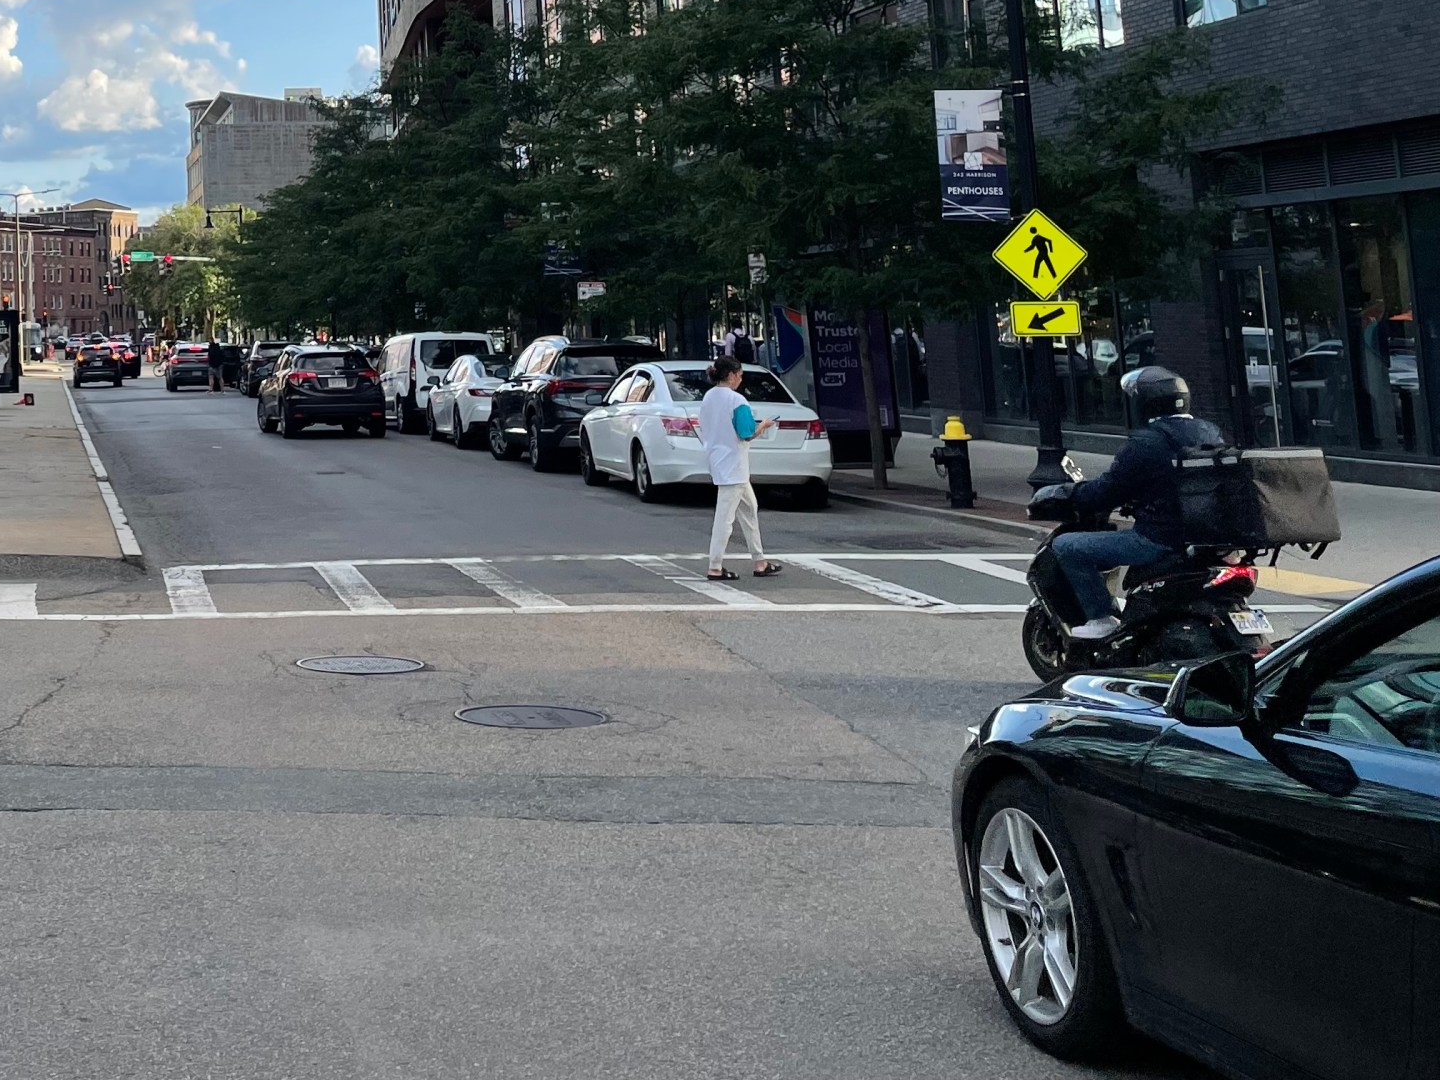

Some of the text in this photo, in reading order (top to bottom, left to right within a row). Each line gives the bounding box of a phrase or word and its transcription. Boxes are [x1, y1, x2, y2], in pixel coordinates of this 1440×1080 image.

[947, 186, 1004, 196] PENTHOUSES
[814, 310, 836, 322] Mo
[817, 341, 852, 353] Local
[819, 356, 858, 368] Media
